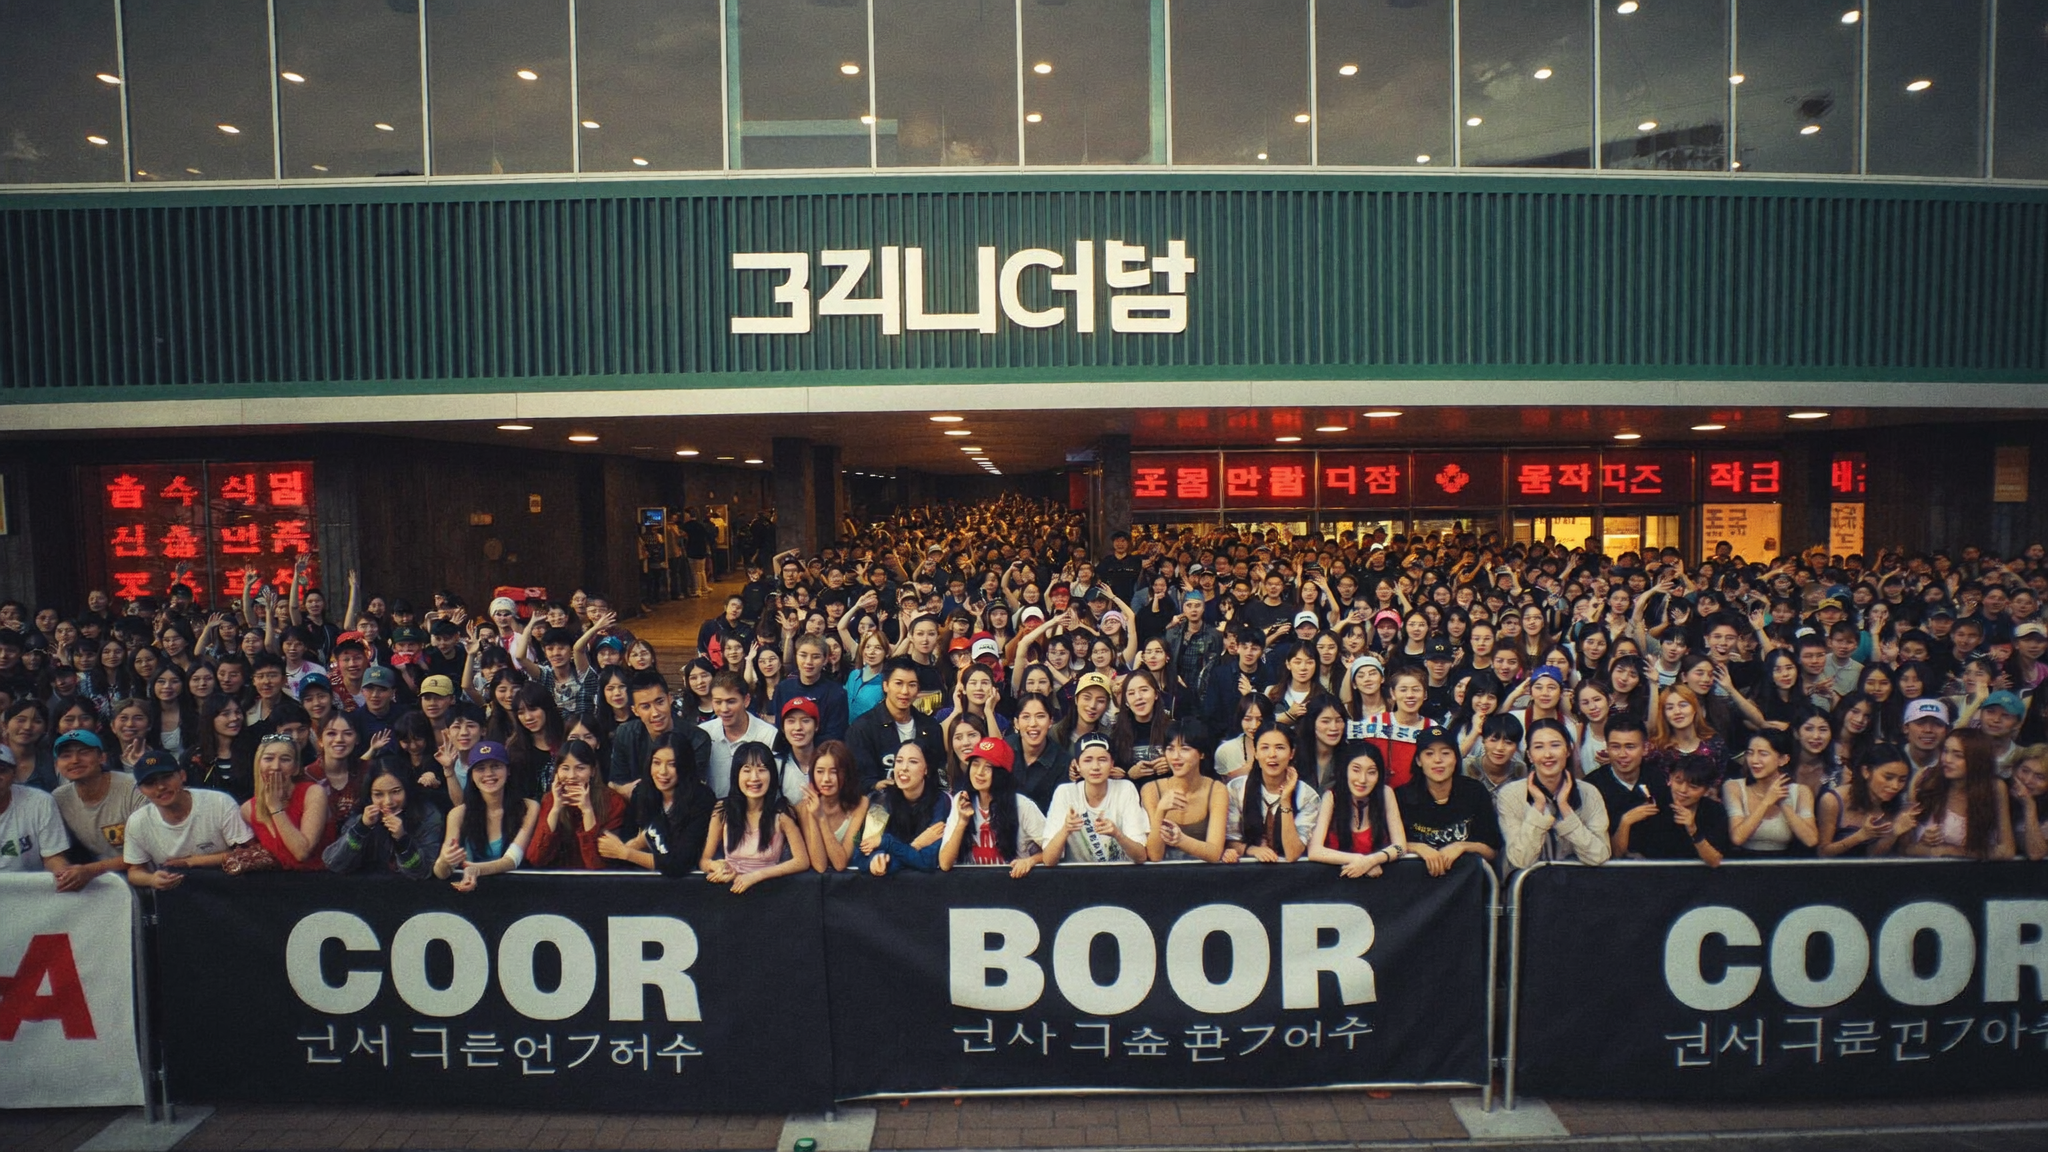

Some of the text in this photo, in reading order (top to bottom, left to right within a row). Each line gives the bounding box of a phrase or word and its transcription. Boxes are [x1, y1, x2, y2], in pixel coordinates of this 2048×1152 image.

[285, 910, 703, 1022] COOR
[948, 903, 1377, 1016] BOOR
[1664, 899, 2048, 1011] COOR
